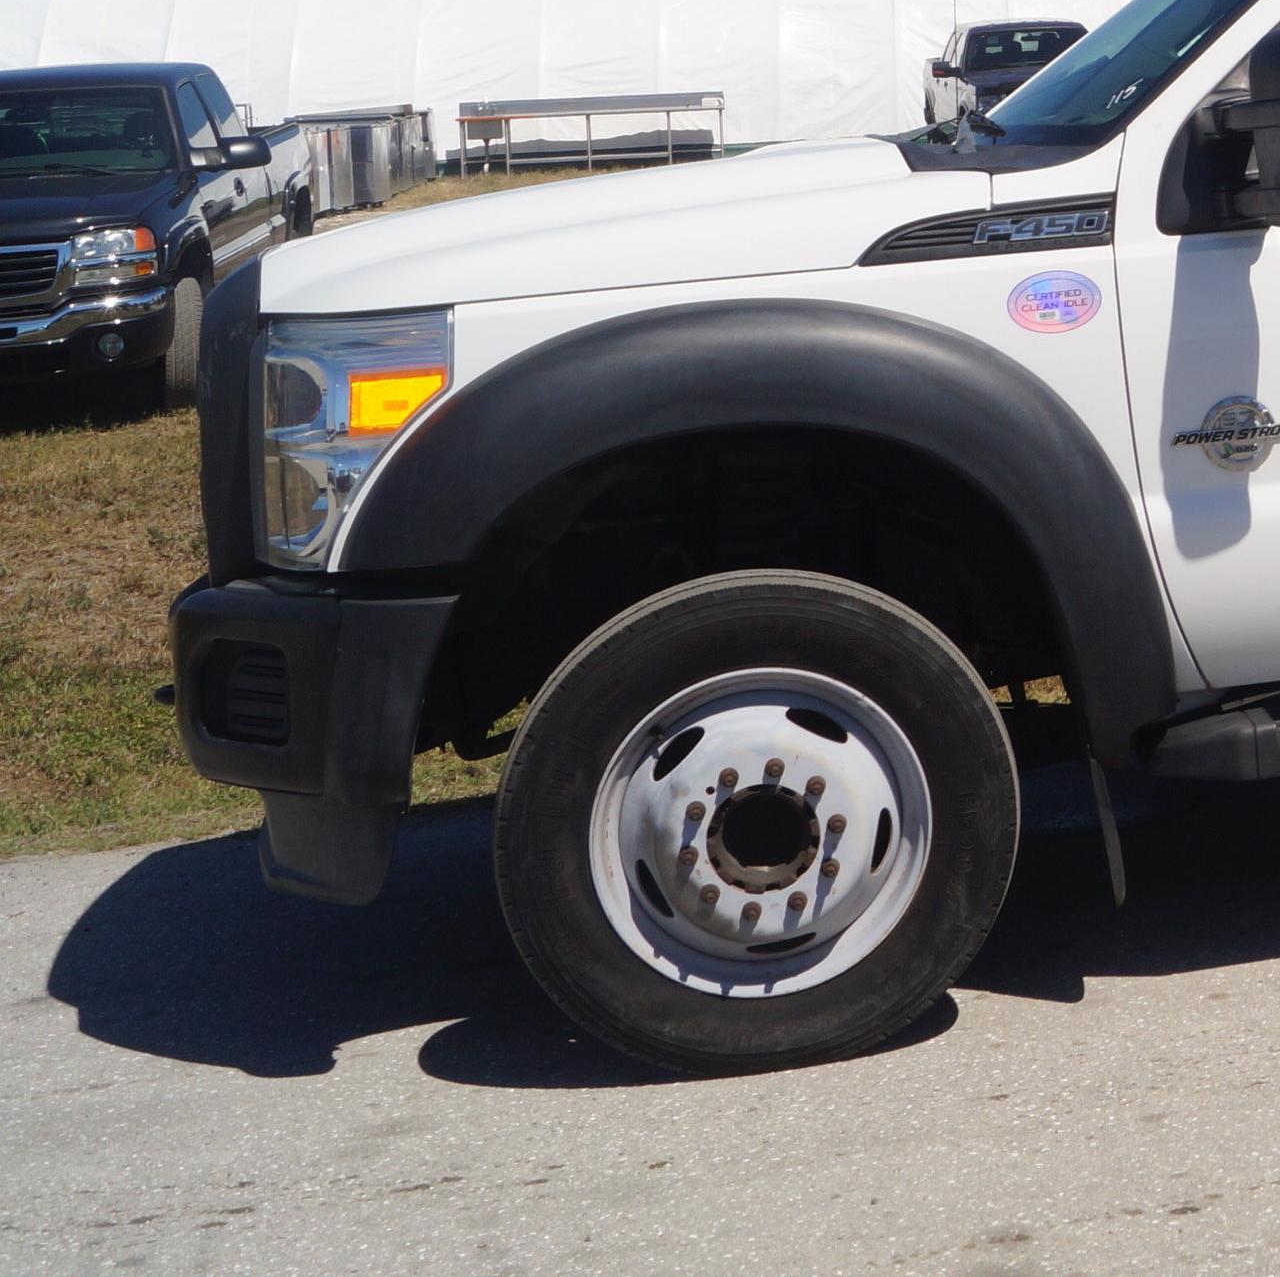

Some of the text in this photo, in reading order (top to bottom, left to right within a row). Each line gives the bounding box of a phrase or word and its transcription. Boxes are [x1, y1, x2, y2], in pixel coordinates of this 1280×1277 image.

[1106, 78, 1144, 109] 115
[972, 210, 1109, 244] F-450
[1026, 289, 1082, 302] CERTIFIED
[1021, 302, 1059, 313] CLEAN
[1063, 298, 1088, 308] IDLE
[1174, 429, 1234, 446] POWER
